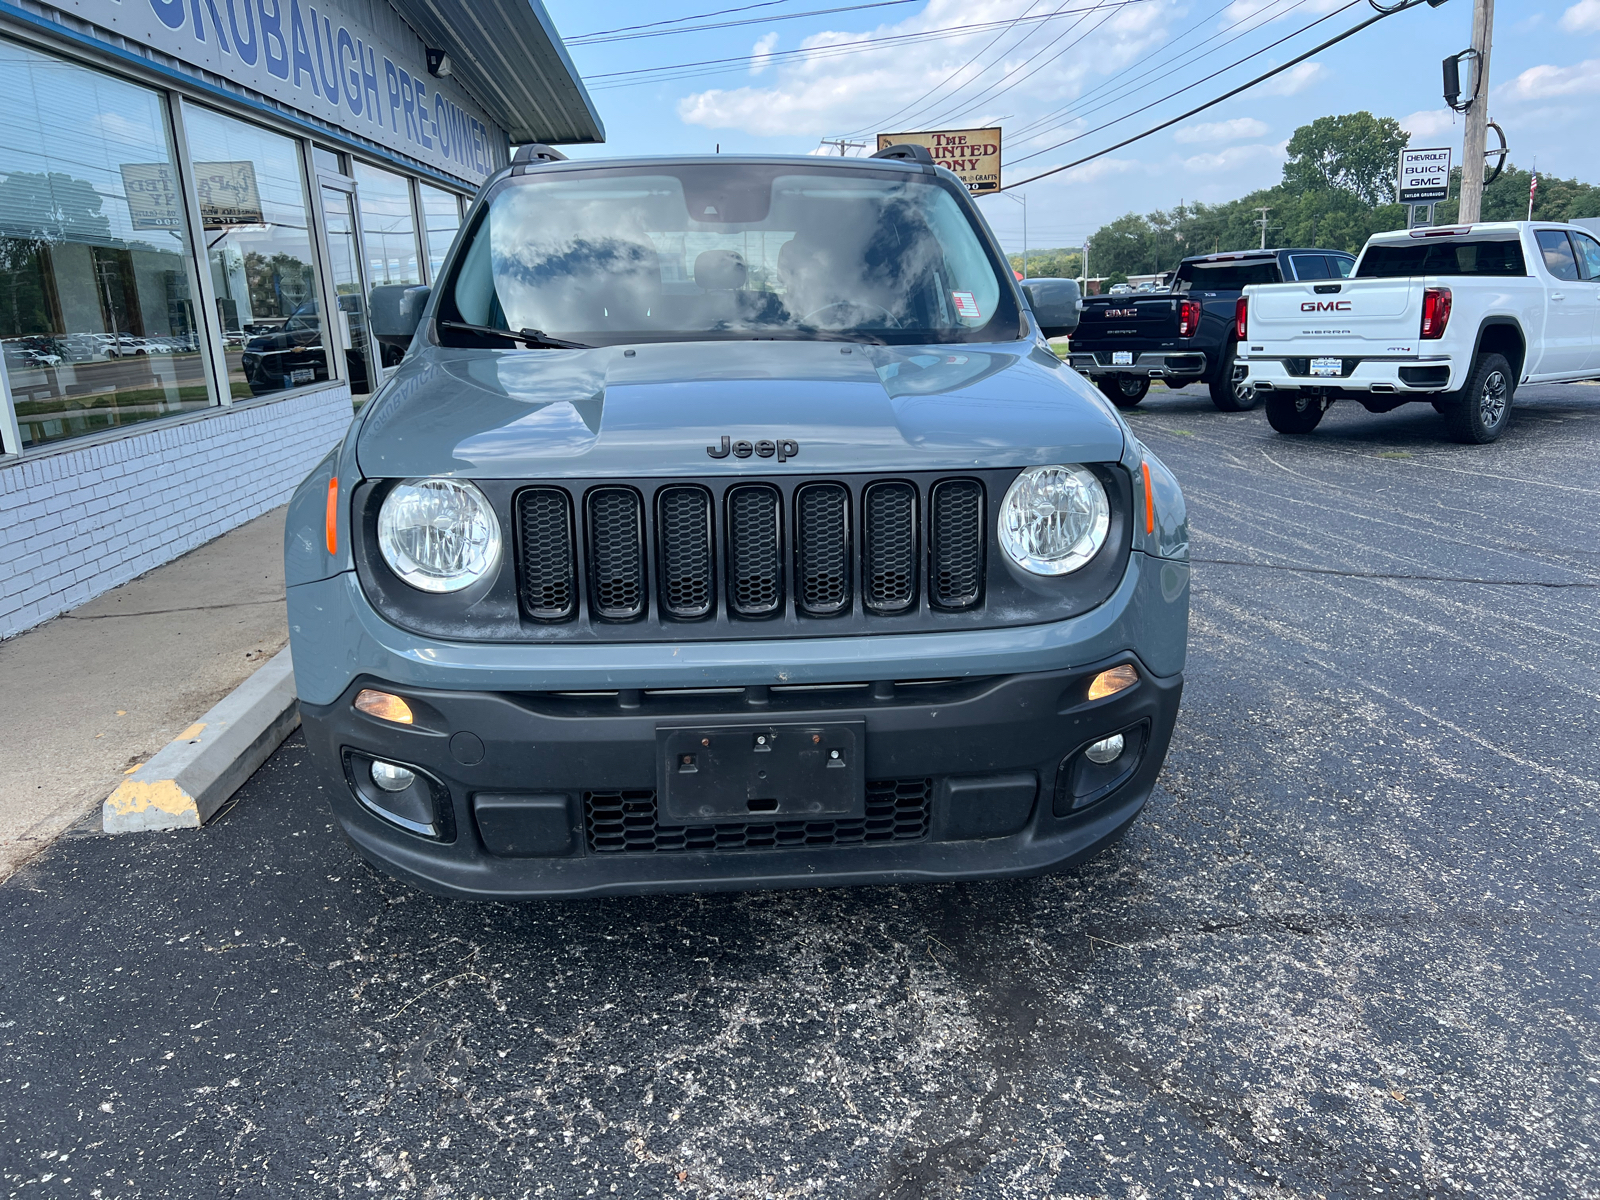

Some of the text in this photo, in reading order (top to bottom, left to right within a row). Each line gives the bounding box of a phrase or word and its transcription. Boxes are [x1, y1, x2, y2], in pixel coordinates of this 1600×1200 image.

[383, 55, 492, 177] PRE-OWNED
[932, 134, 967, 146] THE
[926, 144, 998, 159] AINTED
[1406, 153, 1447, 161] CHEVROLET
[934, 159, 980, 172] ONY
[1405, 165, 1446, 174] BUICK
[1410, 177, 1440, 186] GMC
[1301, 301, 1352, 312] GMC
[1104, 308, 1138, 318] GMC
[706, 435, 799, 463] Jeep
